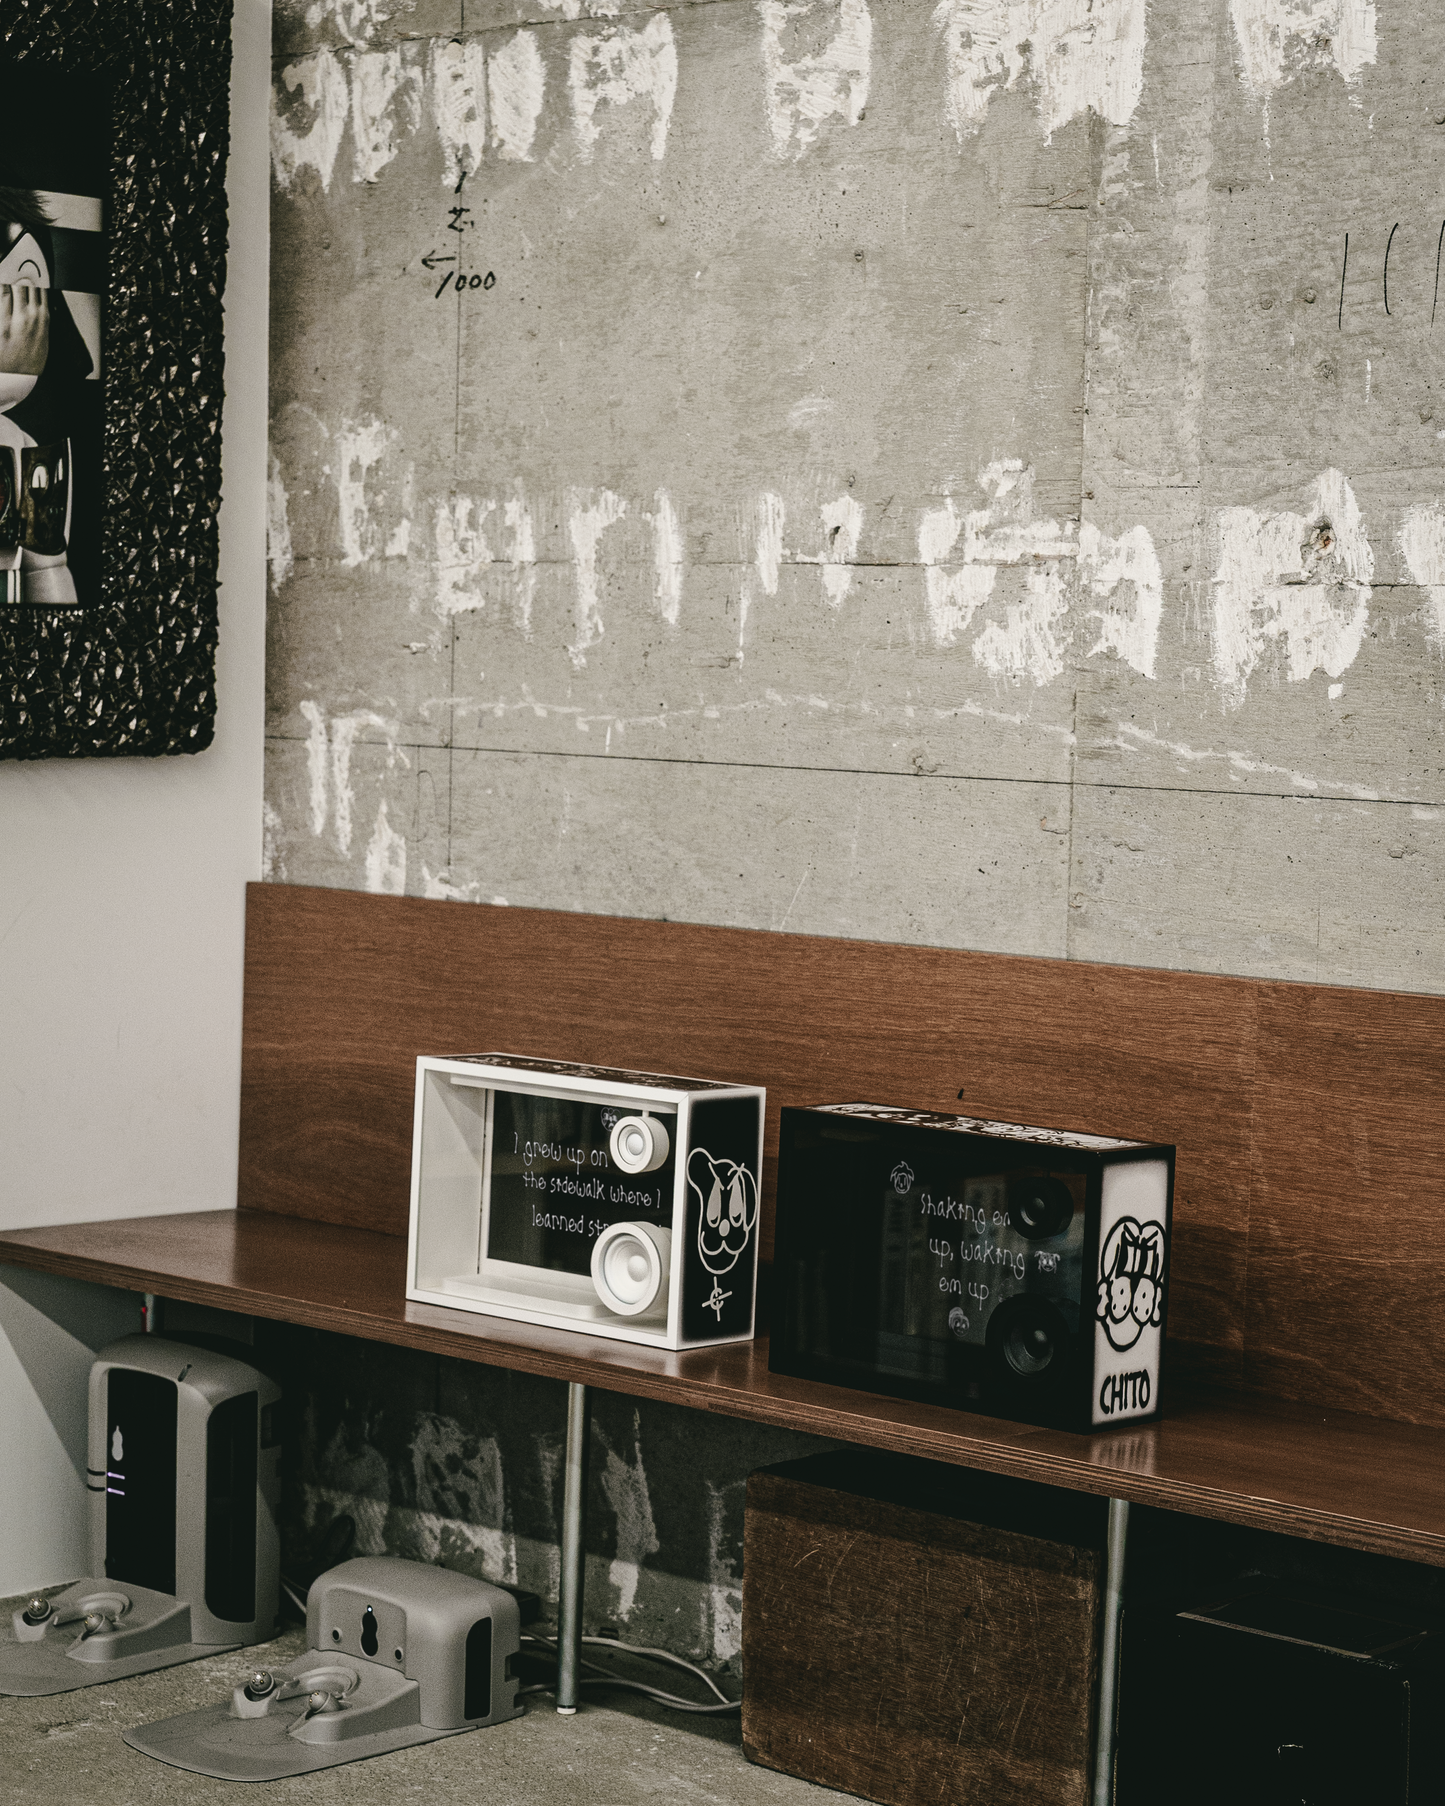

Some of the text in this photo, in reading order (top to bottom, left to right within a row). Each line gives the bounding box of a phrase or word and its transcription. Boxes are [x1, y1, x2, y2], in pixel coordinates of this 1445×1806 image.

[435, 270, 496, 299] 1000
[523, 1141, 562, 1166] grew
[567, 1147, 585, 1175] up
[590, 1149, 608, 1167] on
[523, 1171, 546, 1190] the
[550, 1176, 605, 1200] sidewalk
[610, 1185, 652, 1206] where
[532, 1204, 584, 1233] learned
[929, 1238, 1025, 1280] up, waking
[939, 1277, 989, 1311] em up
[1099, 1368, 1151, 1415] CHITO
